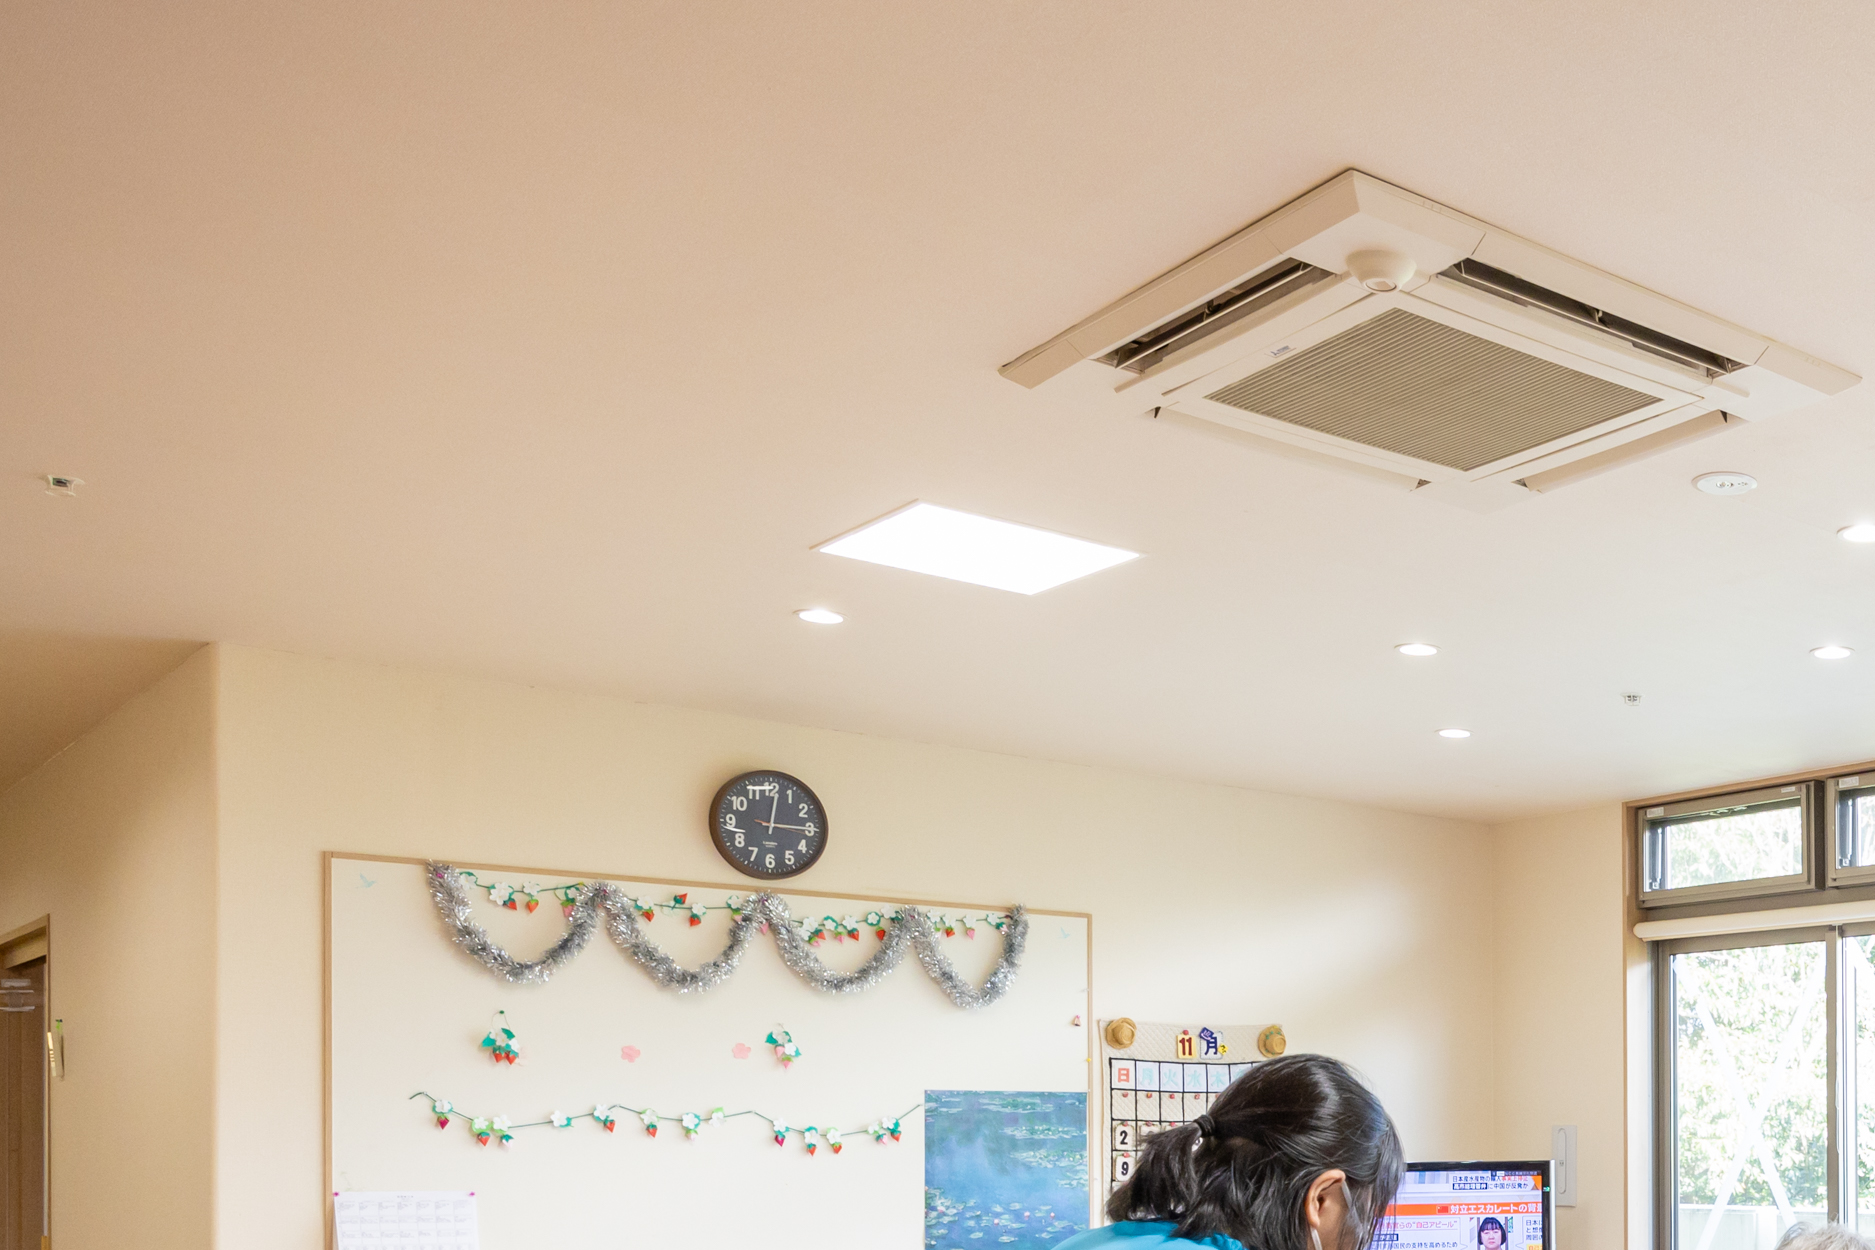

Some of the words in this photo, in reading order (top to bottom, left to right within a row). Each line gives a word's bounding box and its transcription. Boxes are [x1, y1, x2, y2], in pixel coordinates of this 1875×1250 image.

[749, 785, 760, 800] 11
[764, 782, 779, 797] 12
[786, 789, 793, 804] 1
[731, 796, 747, 811] 10
[798, 803, 809, 818] 2
[725, 813, 736, 828] 9
[805, 822, 815, 837] 3
[734, 833, 745, 848] 8
[798, 839, 807, 854] 4
[748, 846, 758, 861] 7
[765, 853, 776, 868] 6
[784, 850, 795, 865] 5
[1178, 1036, 1193, 1056] 11
[1204, 1036, 1218, 1055] 月
[1117, 1067, 1130, 1083] 日
[1141, 1068, 1154, 1087] 月
[1163, 1069, 1179, 1087] 火
[1187, 1070, 1203, 1088] 水
[1210, 1070, 1226, 1088] 木
[1119, 1130, 1128, 1145] 2
[1120, 1161, 1129, 1176] 9
